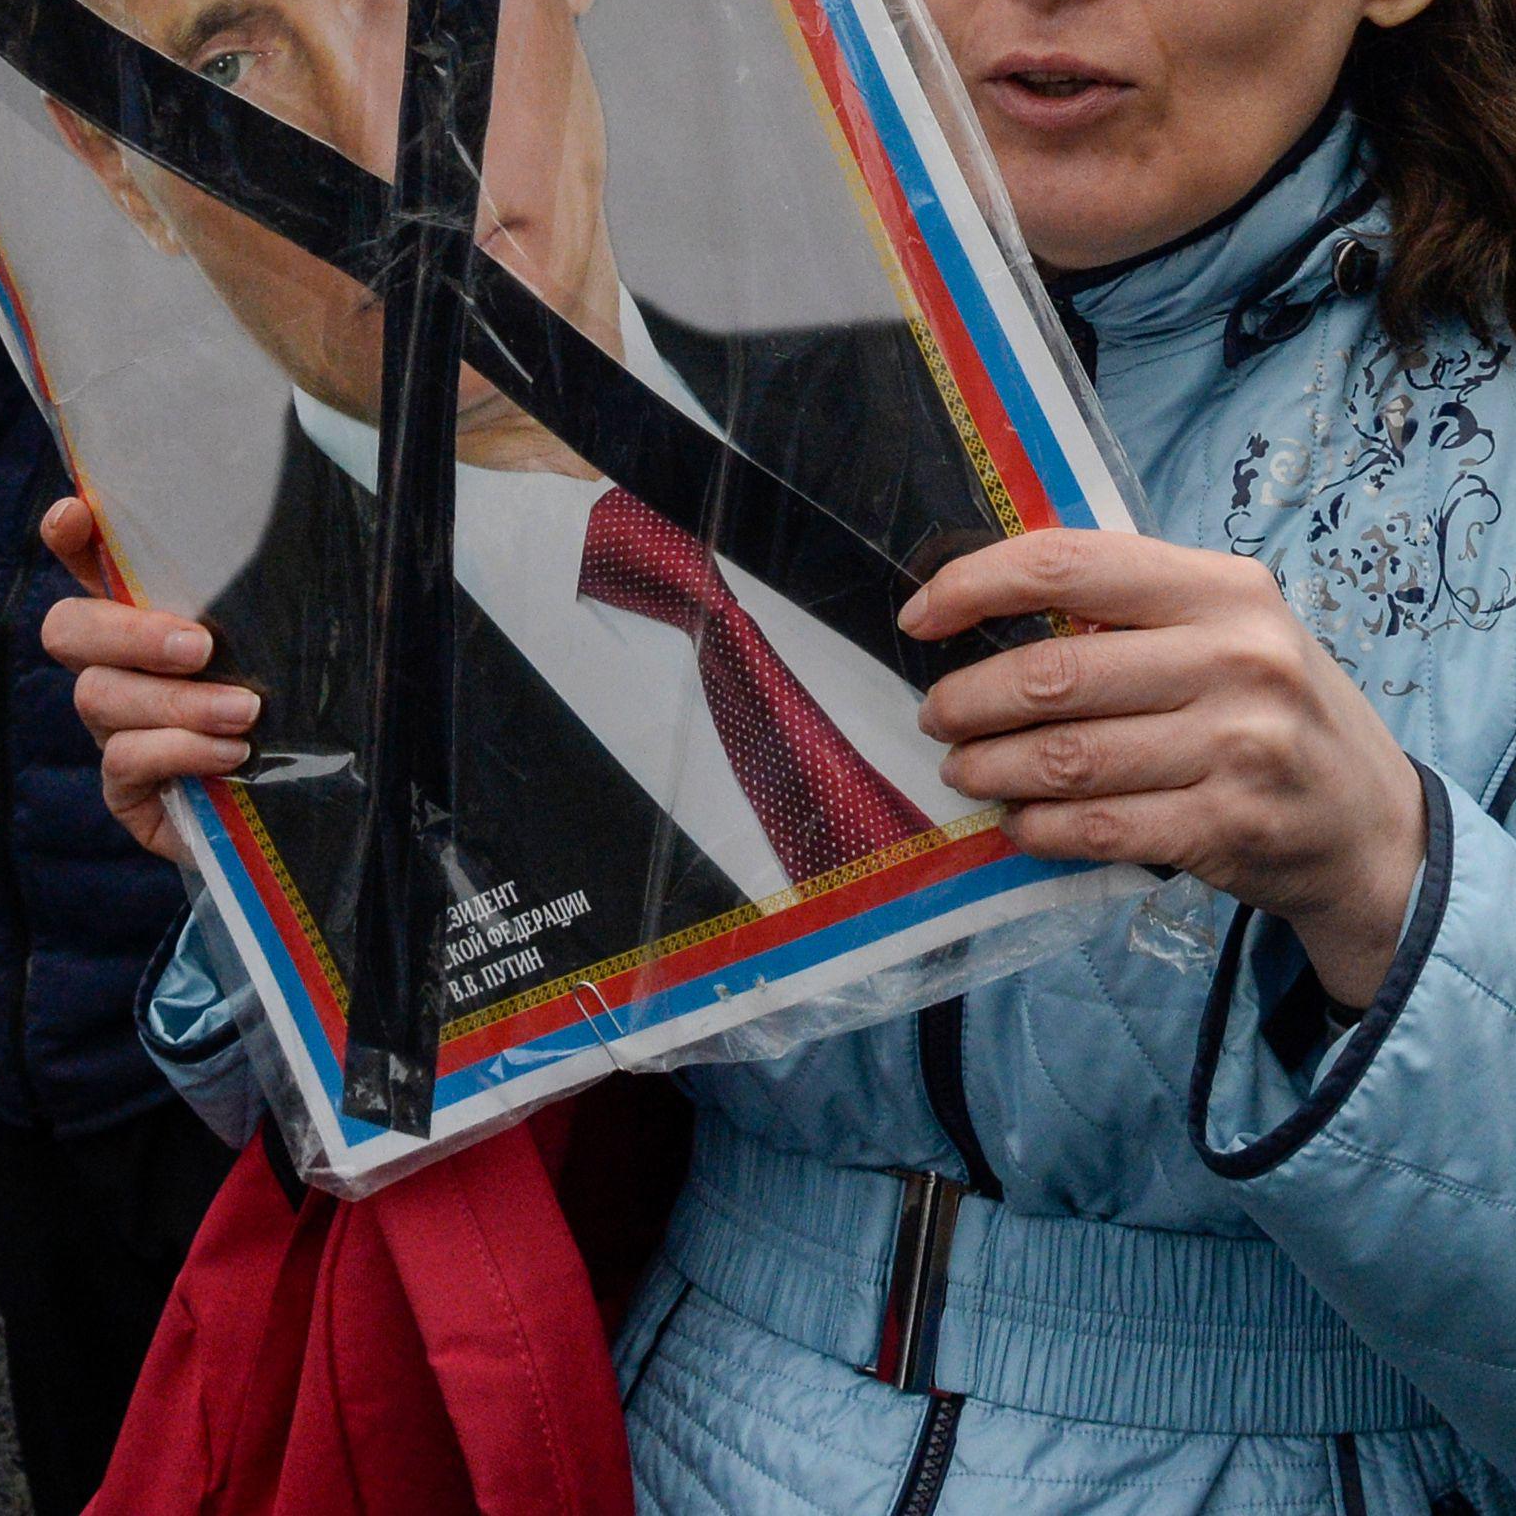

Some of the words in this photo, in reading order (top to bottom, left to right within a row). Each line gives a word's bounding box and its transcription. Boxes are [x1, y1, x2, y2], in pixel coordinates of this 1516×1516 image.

[444, 925, 489, 970] КОЙ
[486, 889, 592, 949] ФЕДЕРАЦИИ
[446, 880, 520, 932] ЗИДЕНТ
[448, 972, 483, 1003] В.В.
[480, 946, 545, 990] ПУТИН
